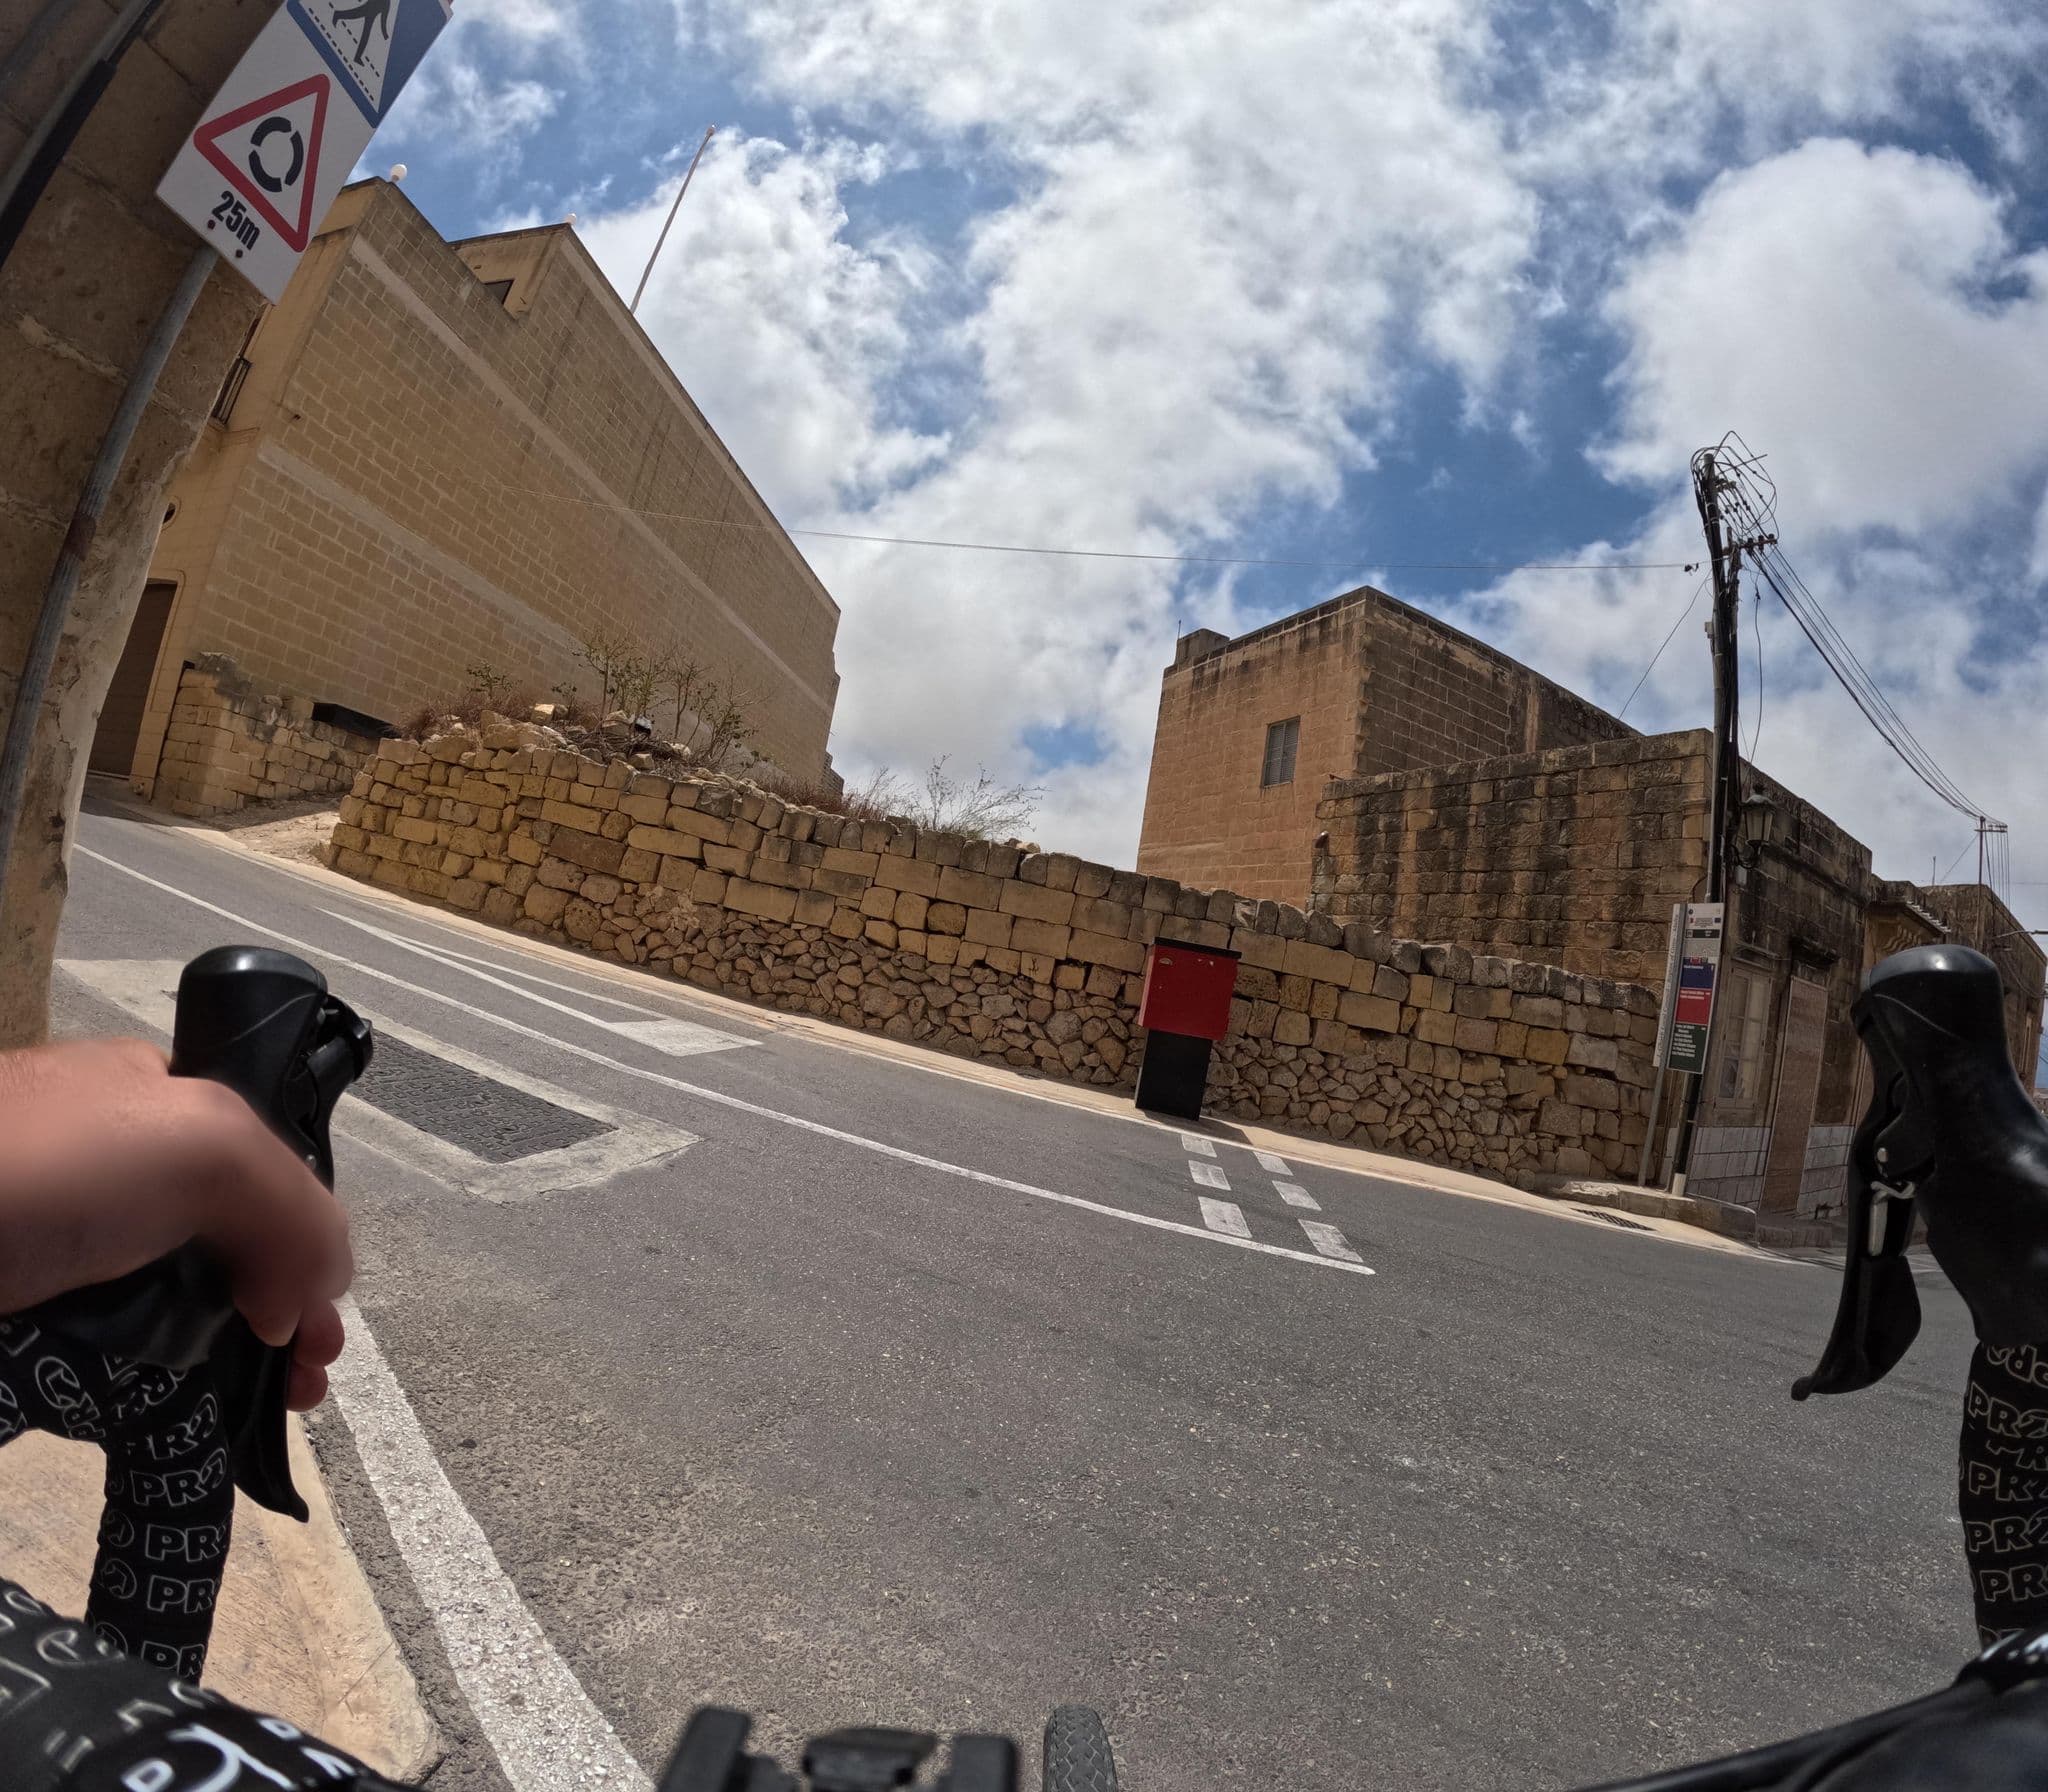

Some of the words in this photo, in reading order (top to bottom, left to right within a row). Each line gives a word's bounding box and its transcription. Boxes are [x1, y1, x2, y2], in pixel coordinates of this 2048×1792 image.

[211, 190, 260, 251] 25m
[147, 1574, 216, 1614] PR
[1979, 1563, 2048, 1602] PR
